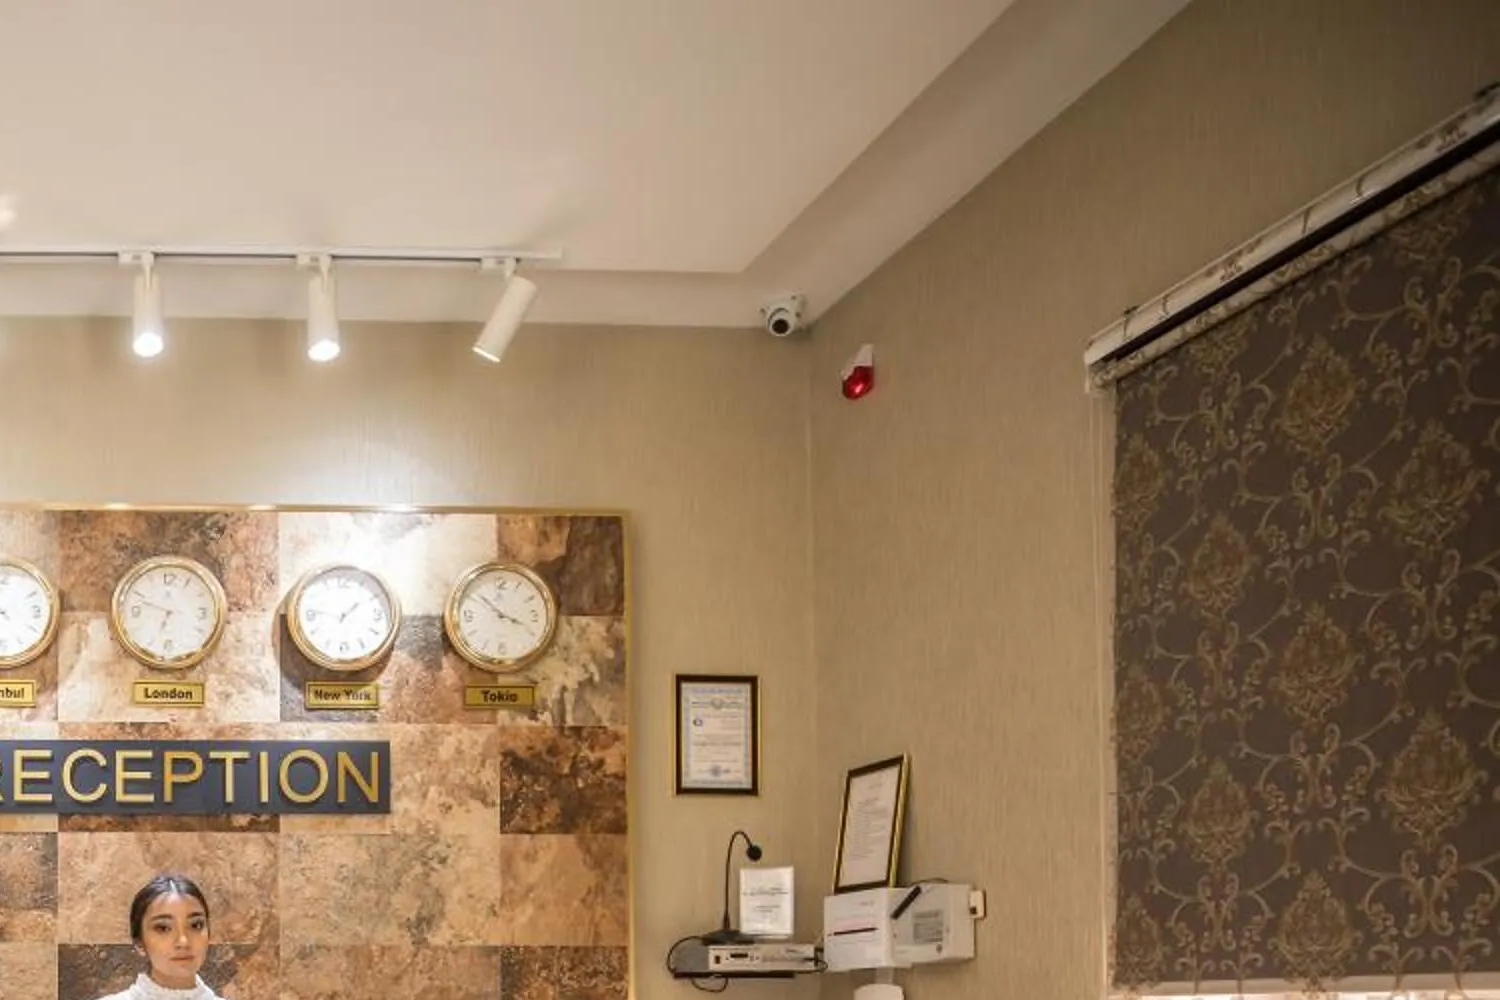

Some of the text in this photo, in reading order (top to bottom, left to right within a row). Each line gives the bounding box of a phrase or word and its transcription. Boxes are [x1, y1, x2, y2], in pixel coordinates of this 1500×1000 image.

[144, 687, 194, 700] London
[314, 689, 371, 701] New York
[481, 690, 517, 703] Tokio
